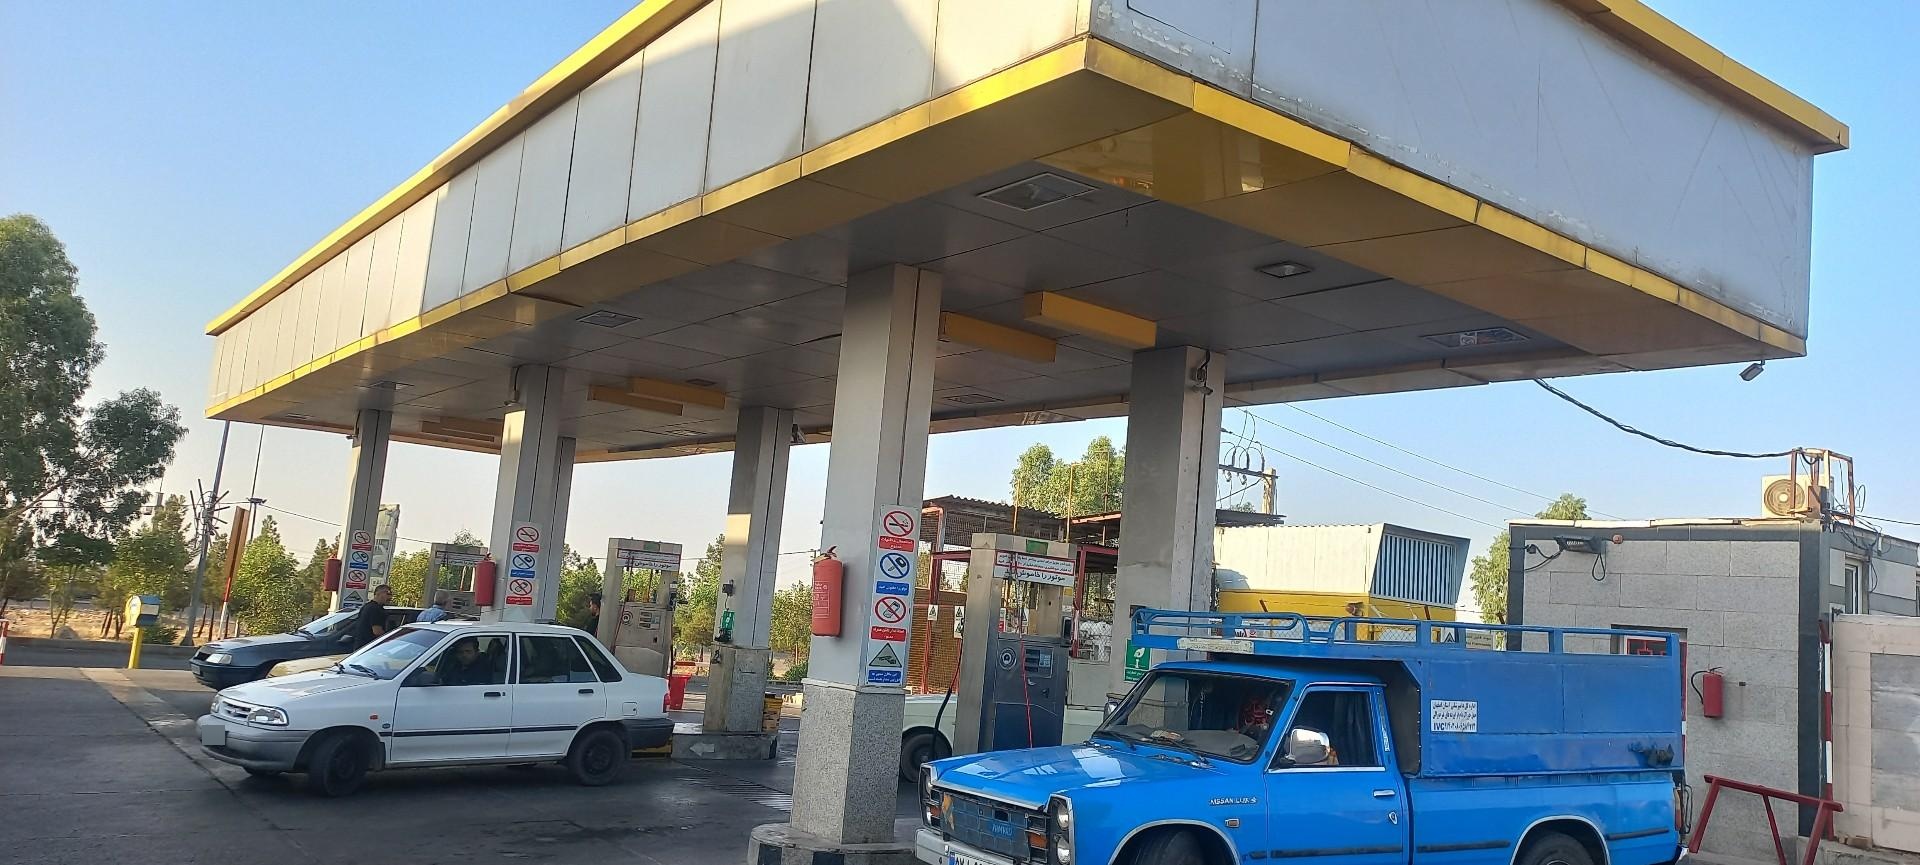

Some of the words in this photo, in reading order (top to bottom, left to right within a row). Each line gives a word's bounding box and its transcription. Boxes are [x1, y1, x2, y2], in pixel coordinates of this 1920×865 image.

[1017, 570, 1040, 579] خاموش
[1047, 574, 1065, 582] موتور
[1210, 797, 1234, 805] NISSAN
